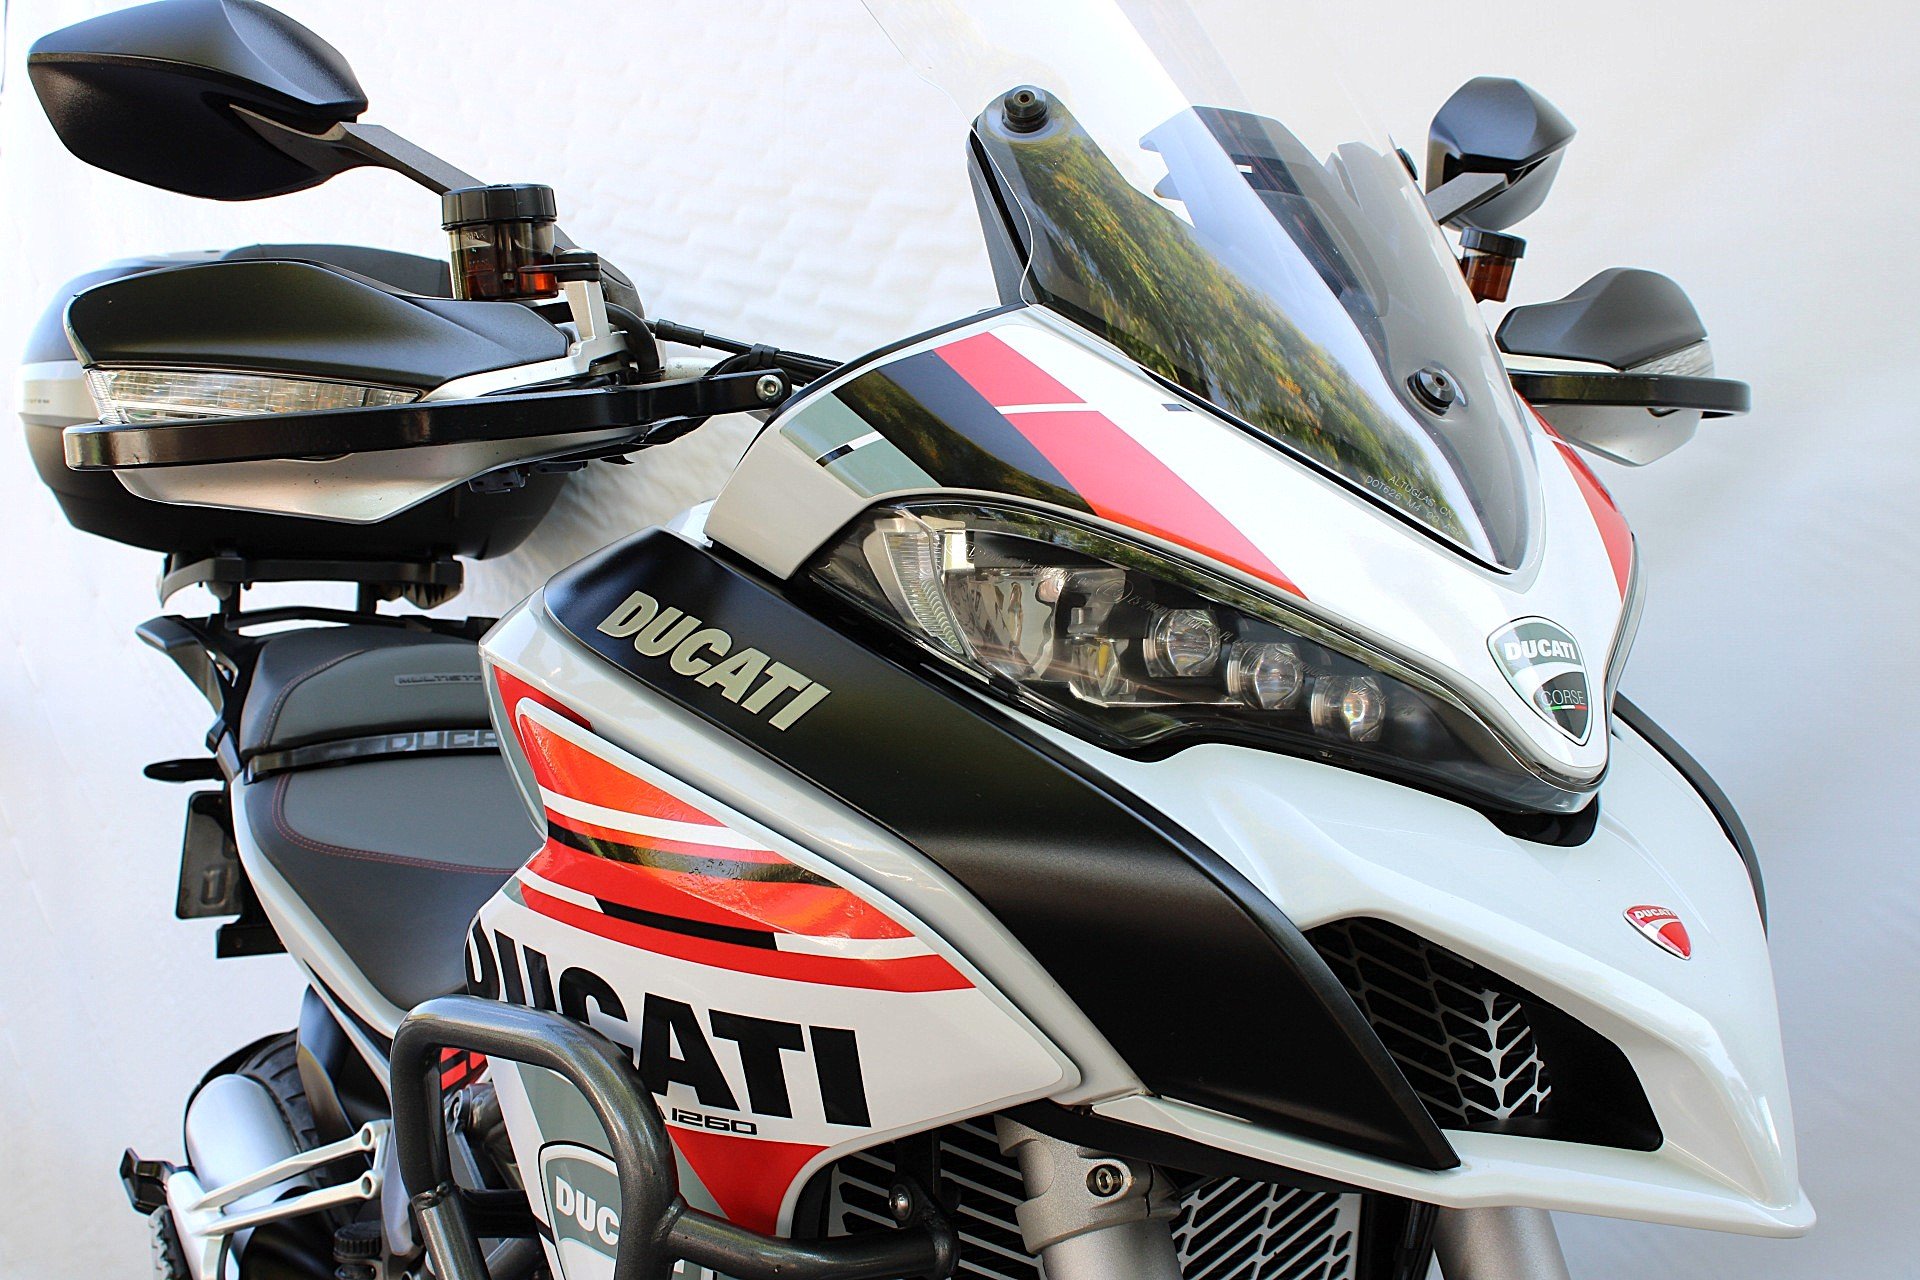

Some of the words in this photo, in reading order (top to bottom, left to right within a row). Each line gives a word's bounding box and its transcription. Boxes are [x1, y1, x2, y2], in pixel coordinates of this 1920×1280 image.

[1365, 475, 1403, 501] DOT626
[1388, 475, 1436, 507] ALTUGLAS
[1439, 506, 1455, 519] CN
[596, 590, 832, 731] DUCATI
[1503, 639, 1577, 661] DUCATI
[1541, 690, 1586, 706] CORSE
[1633, 909, 1677, 919] DUCATI
[671, 1107, 758, 1136] 1260
